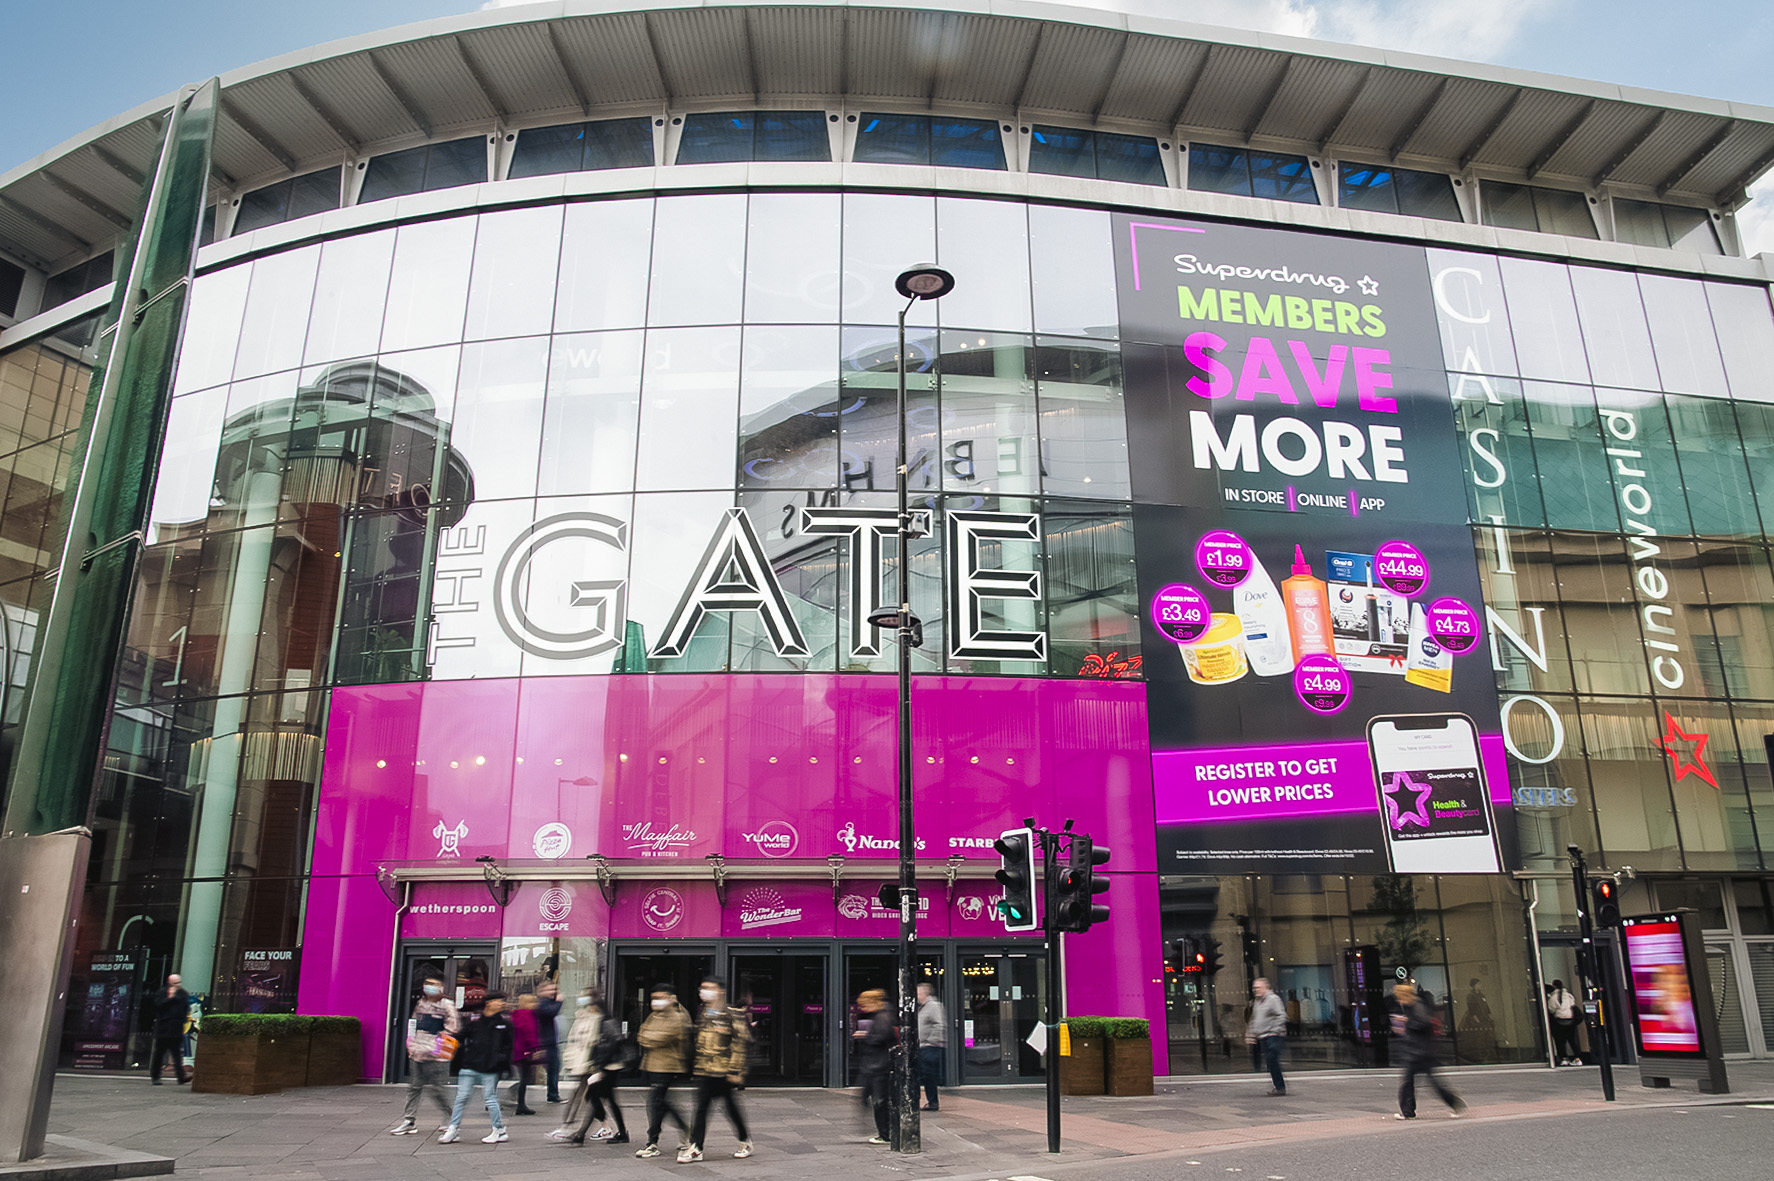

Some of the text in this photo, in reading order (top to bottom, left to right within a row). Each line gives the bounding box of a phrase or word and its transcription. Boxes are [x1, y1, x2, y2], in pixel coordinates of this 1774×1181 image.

[1174, 254, 1349, 294] Superdrug
[1178, 286, 1387, 338] MEMBERS
[1183, 331, 1398, 414] SAVE
[1189, 410, 1408, 484] MORE
[1225, 488, 1385, 511] IN STORE ONLINE APP
[1432, 266, 1564, 765] CASINO
[1206, 549, 1242, 567] £1.99
[1599, 409, 1684, 690] cineworld
[1379, 559, 1423, 577] £44.99
[428, 506, 1047, 667] THE GATE
[1244, 591, 1268, 602] Dove
[1162, 604, 1201, 622] £3.49
[1435, 616, 1470, 633] £4.73
[1304, 674, 1341, 691] £4.99
[1195, 758, 1338, 782] REGISTER TO GET
[1208, 784, 1334, 806] LOWER PRICES
[1432, 799, 1467, 809] Health &
[1434, 808, 1479, 818] Beautycard
[622, 824, 634, 832] THE
[623, 822, 697, 849] Mayfair
[540, 838, 561, 848] Pizza
[742, 832, 791, 843] YuMe
[764, 840, 790, 848] world
[858, 835, 926, 850] Nan's
[948, 837, 999, 848] STARB
[544, 844, 560, 853] Hut
[409, 903, 496, 914] wetherspoon
[539, 923, 569, 931] ESCAPE
[244, 951, 292, 960] FACE YOUR
[91, 963, 112, 971] WORLD
